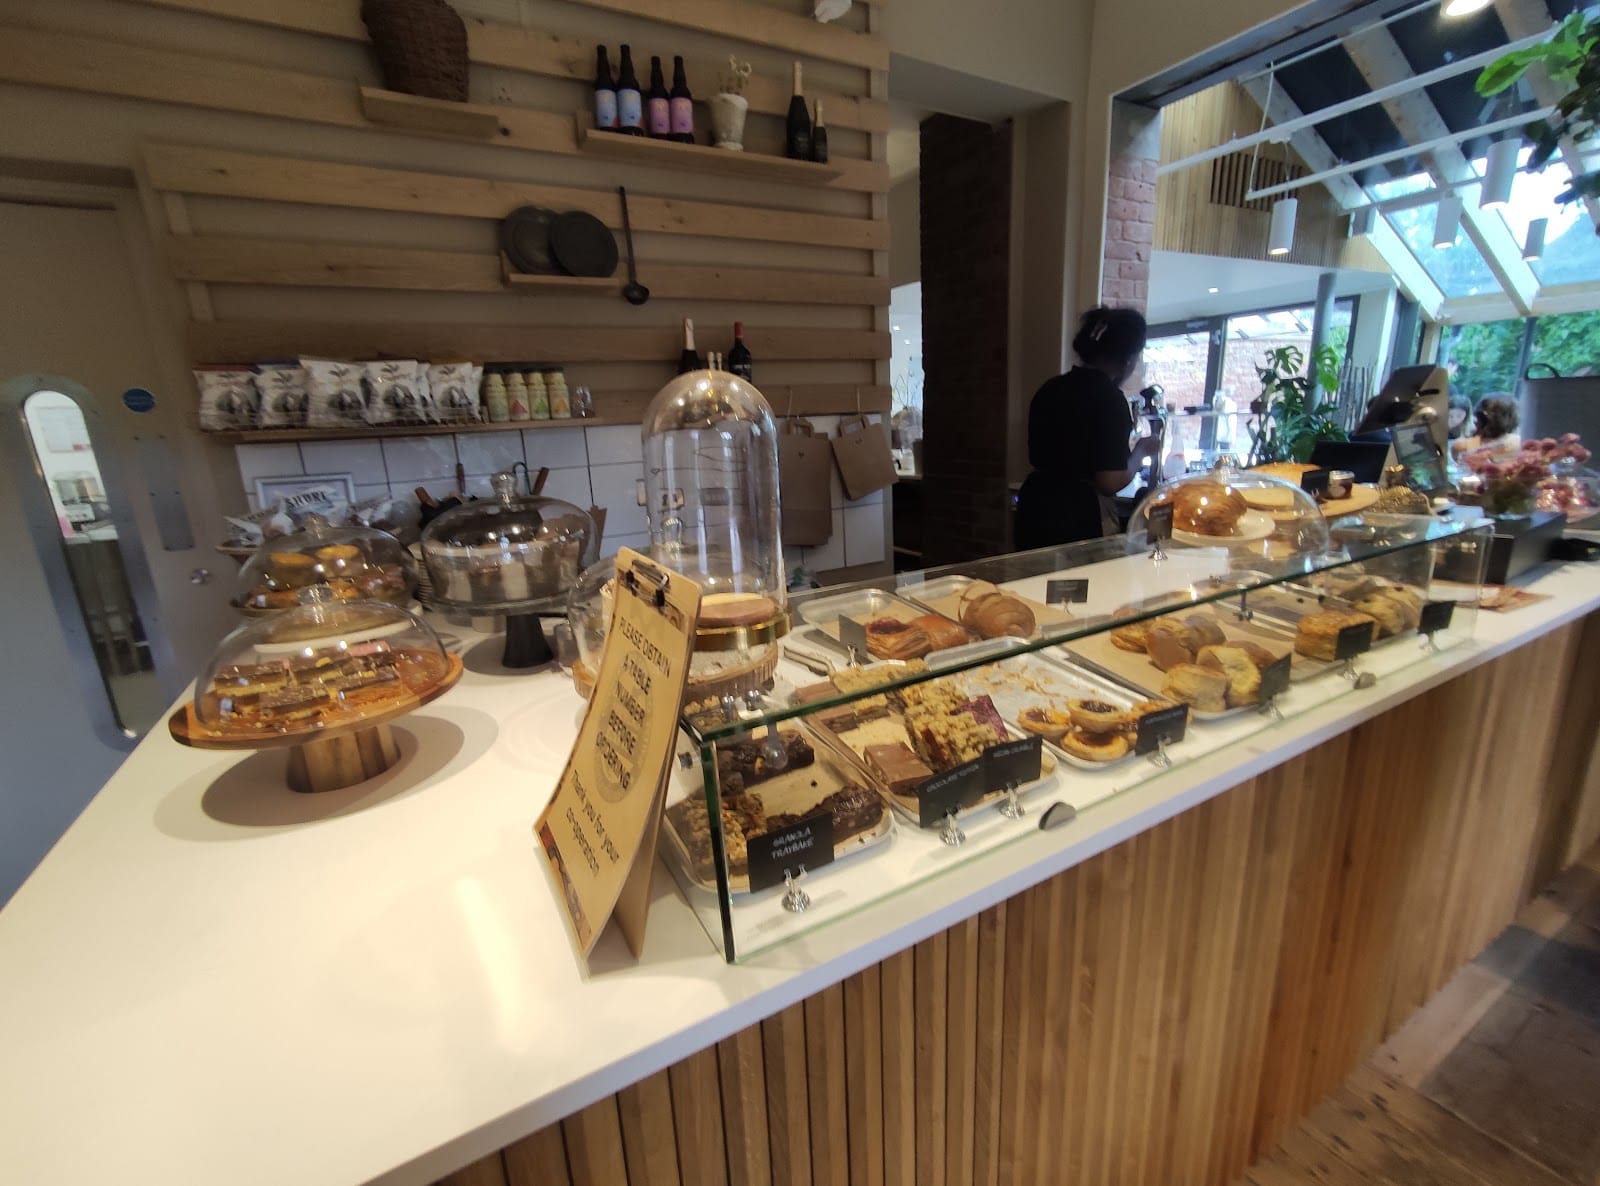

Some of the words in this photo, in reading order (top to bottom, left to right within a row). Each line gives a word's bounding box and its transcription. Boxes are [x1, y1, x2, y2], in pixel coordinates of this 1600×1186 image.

[619, 616, 643, 650] PLEASE
[642, 638, 671, 679] OBTAIN
[623, 653, 629, 671] A
[629, 659, 652, 695] TABLE
[616, 680, 646, 727] NUMBER
[608, 710, 636, 755] BEFORE
[596, 731, 631, 790] ORDERING
[566, 806, 600, 877] co-operation
[573, 768, 587, 803] Thank
[582, 800, 597, 823] you
[594, 813, 605, 838] for
[600, 833, 620, 865] your
[771, 836, 815, 860] TRAYBAKE
